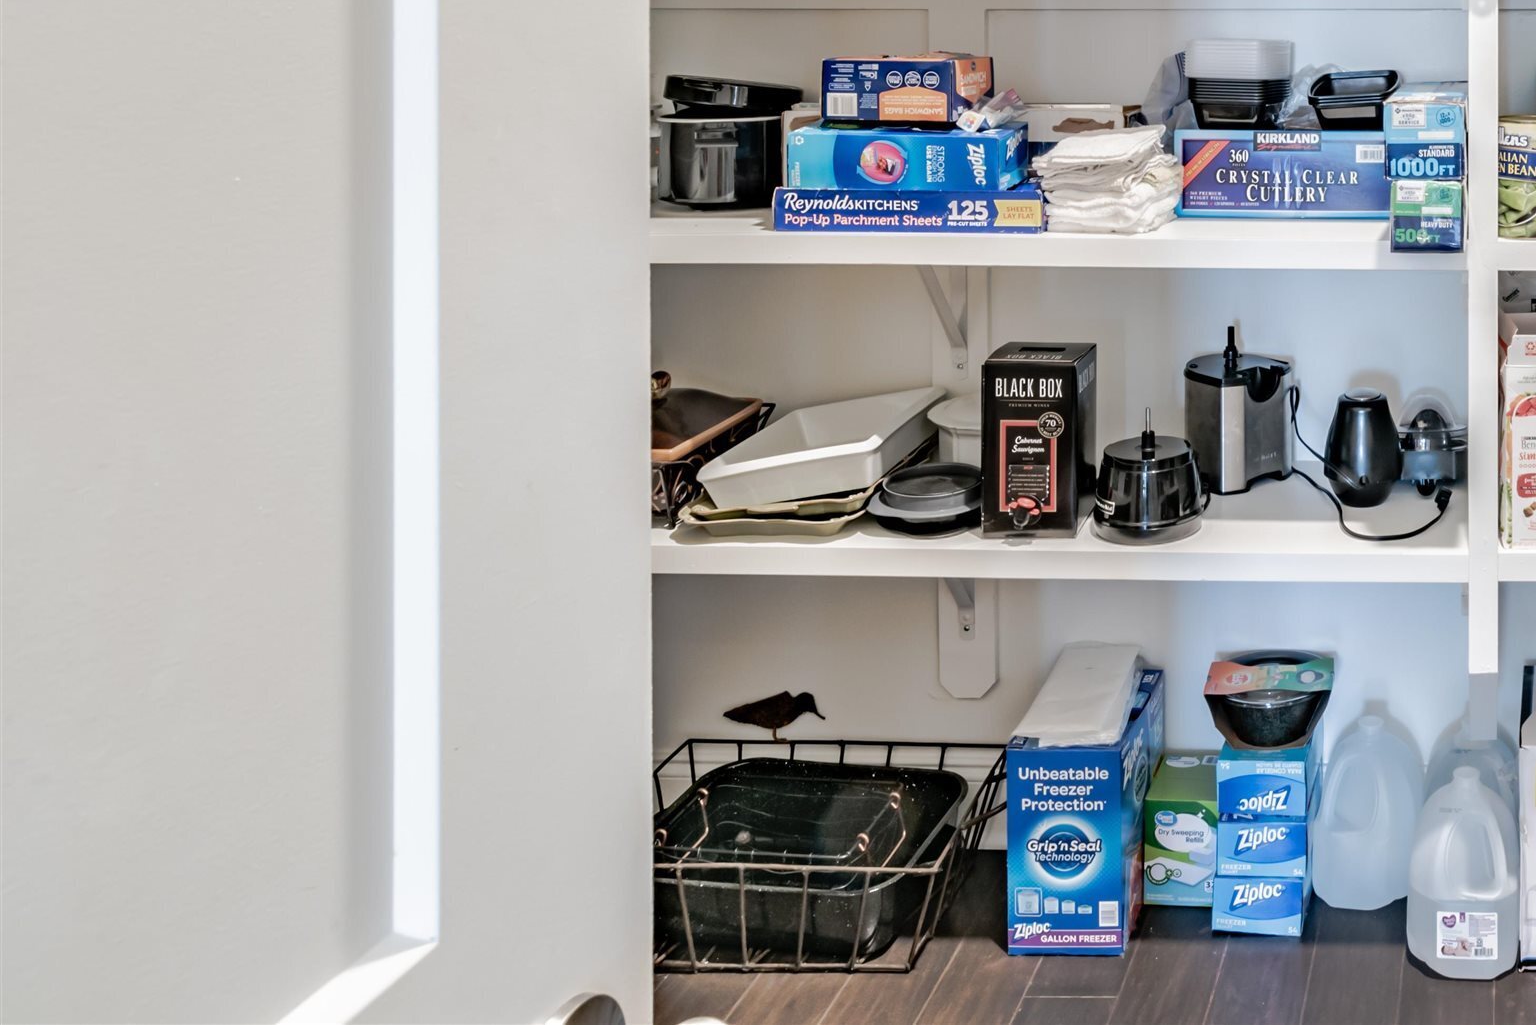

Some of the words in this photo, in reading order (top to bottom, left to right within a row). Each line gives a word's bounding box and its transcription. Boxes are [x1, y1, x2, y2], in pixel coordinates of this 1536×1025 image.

[960, 71, 986, 84] SANDWICH
[884, 107, 902, 115] BAGS
[904, 107, 944, 115] SANDWICH
[1256, 133, 1320, 144] KIRKLAND
[1256, 142, 1319, 152] Signature
[1418, 149, 1455, 157] STANDARD
[1229, 149, 1249, 163] 360
[937, 145, 945, 182] STRONG
[967, 143, 987, 186] Ziploc
[1216, 168, 1293, 184] CRYSTAL
[1302, 169, 1359, 184] CLEAR
[1246, 184, 1328, 203] CUTLERY
[783, 192, 854, 214] Reynolds
[854, 199, 918, 211] KITCHENS
[947, 200, 989, 220] 125
[785, 213, 831, 227] Pop-Up
[833, 213, 899, 226] Parchment
[902, 214, 943, 227] Sheets
[995, 377, 1034, 397] BLACK
[1039, 378, 1063, 398] BOX
[1015, 436, 1042, 445] Cabernet
[1011, 444, 1045, 454] Sauvignon
[1018, 767, 1109, 780] Unbeatable
[1034, 783, 1093, 795] Freezer
[1237, 790, 1288, 811] Ziploc
[1171, 830, 1205, 838] Sweeping
[1238, 827, 1288, 850] Ziploc
[1027, 840, 1068, 853] Grip'n
[1069, 840, 1101, 852] Seal
[1035, 852, 1095, 863] Technology
[1233, 883, 1285, 905] Ziploc
[1014, 922, 1051, 939] Ziploc
[1041, 935, 1077, 943] GALLON
